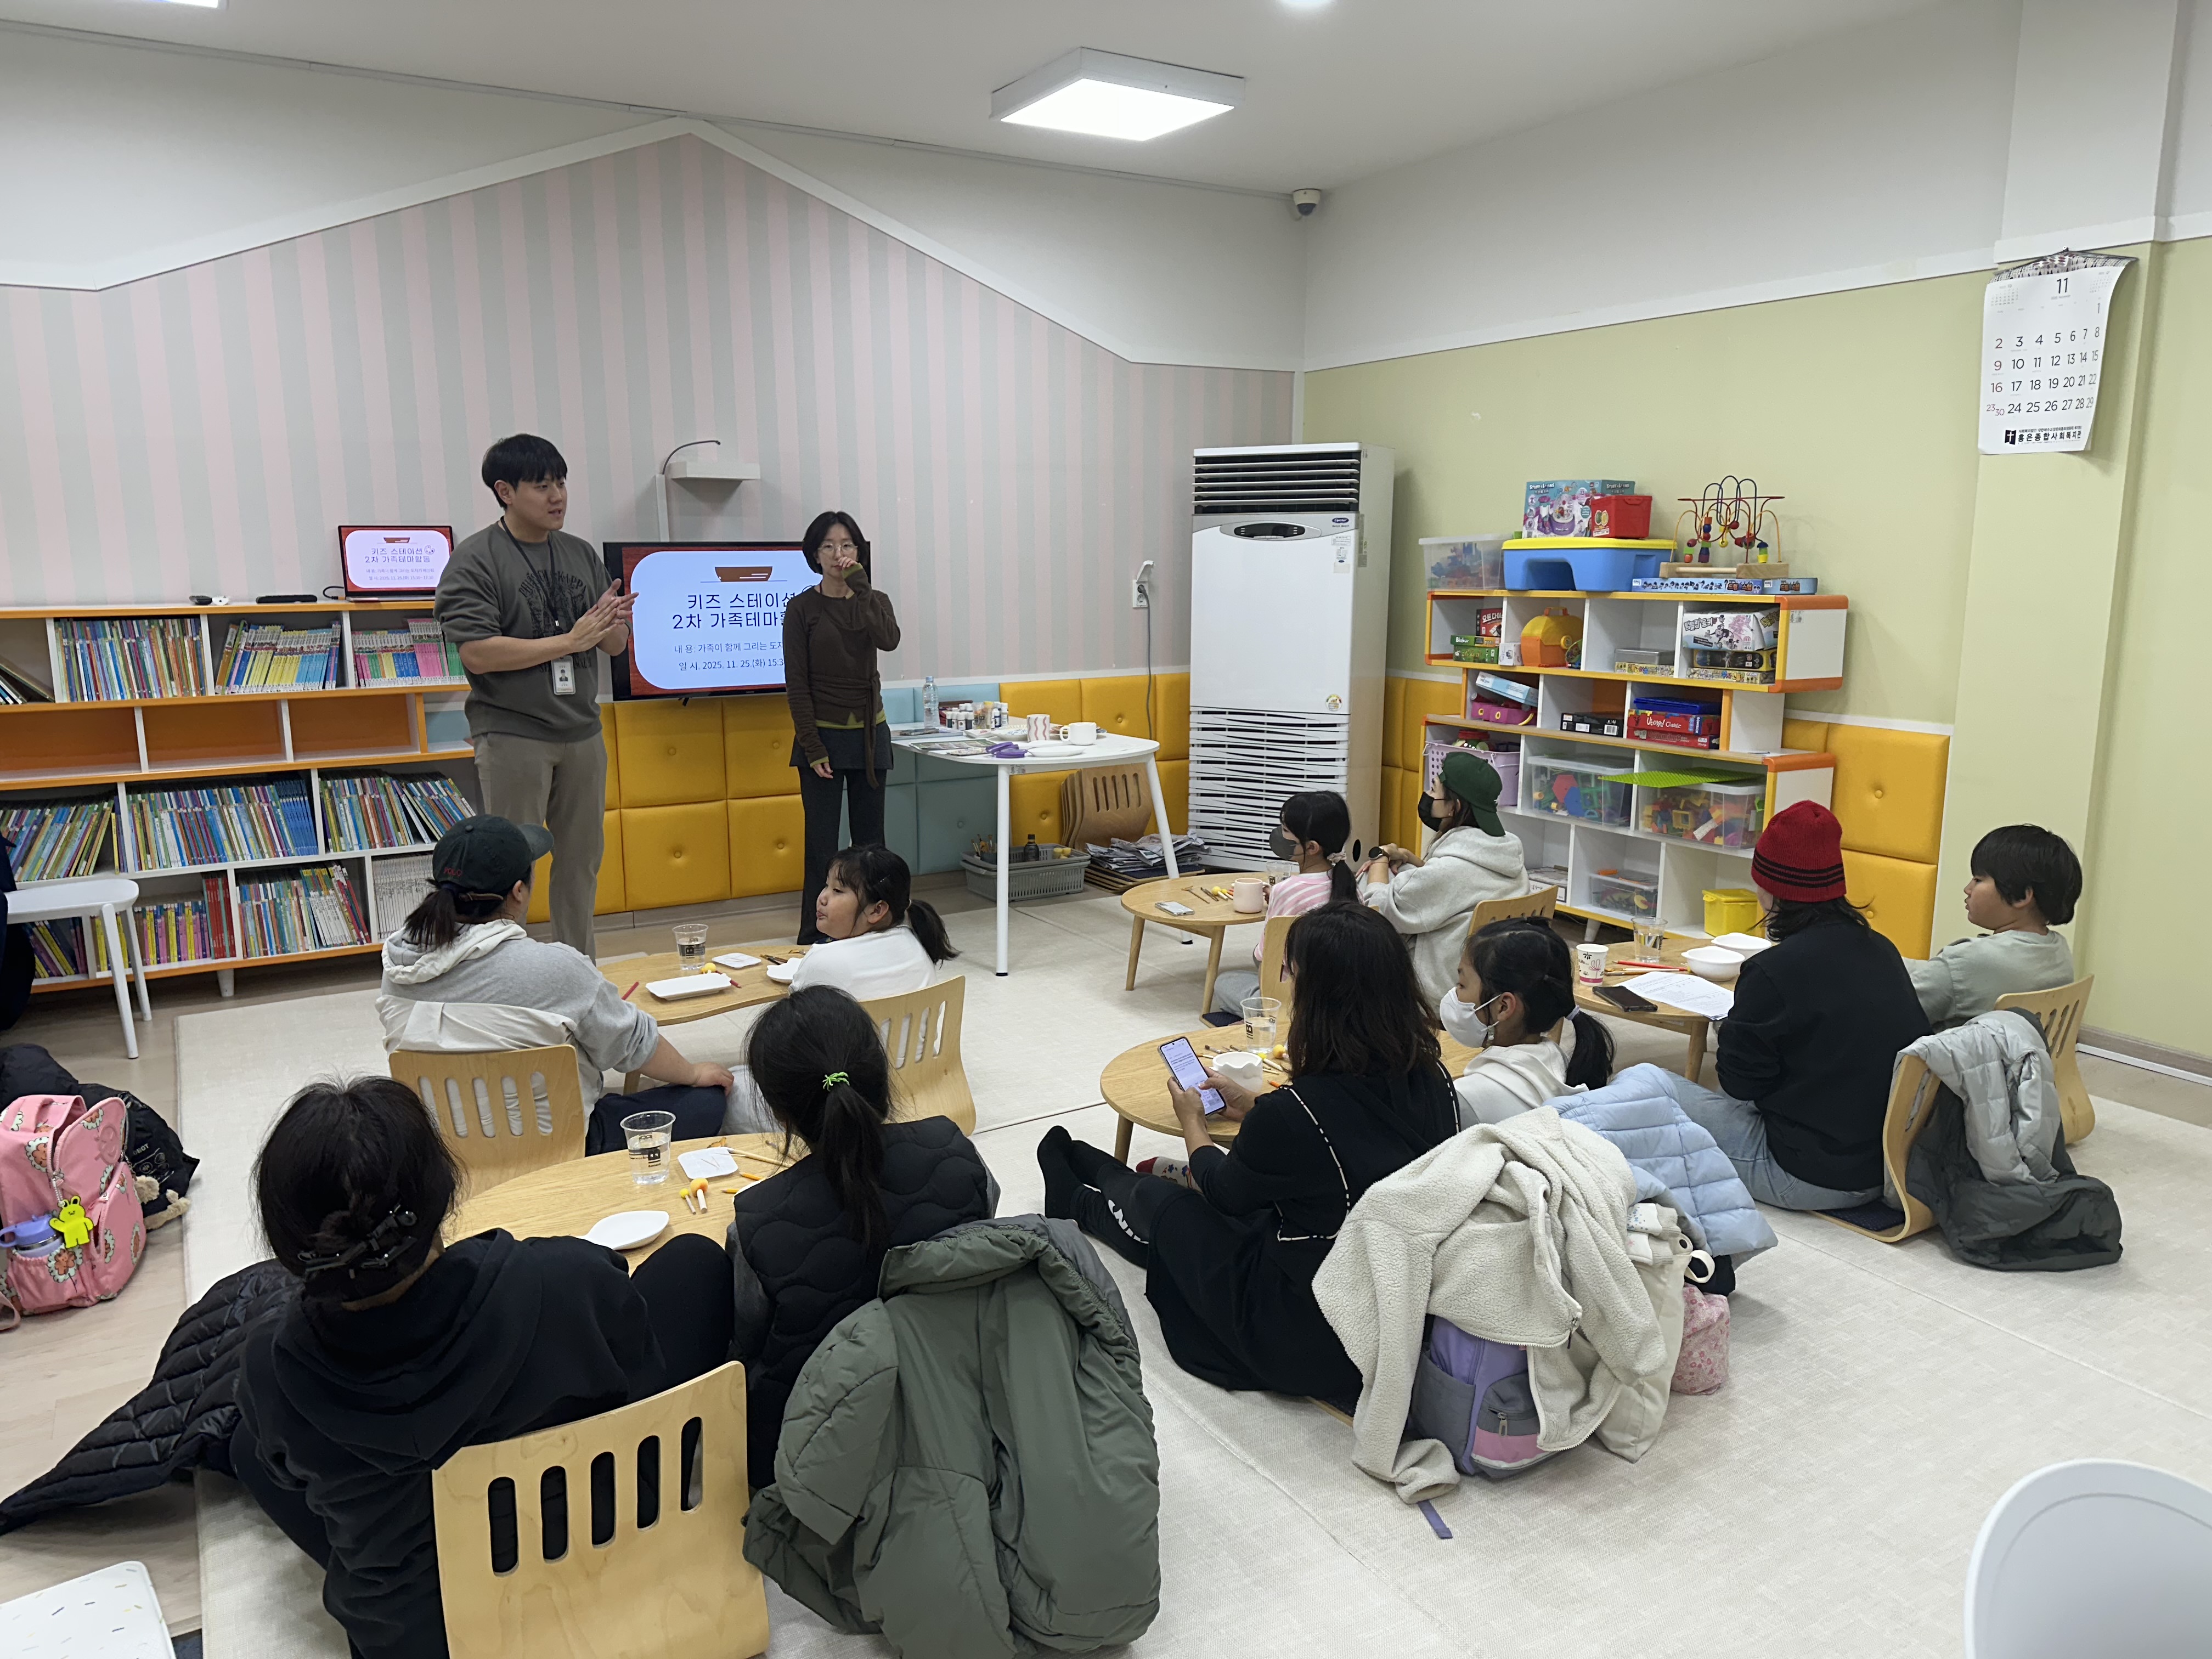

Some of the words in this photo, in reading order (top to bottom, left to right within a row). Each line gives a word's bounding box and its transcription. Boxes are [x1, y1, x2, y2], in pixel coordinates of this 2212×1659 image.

[2057, 278, 2068, 294] 11
[1995, 338, 2003, 348] 2
[2016, 336, 2023, 347] 3
[2035, 335, 2043, 345] 4
[2055, 332, 2061, 343] 5
[2070, 330, 2075, 341] 6
[2084, 329, 2087, 339] 7
[2095, 327, 2100, 337] 8
[1994, 360, 2002, 371] 9
[2012, 359, 2024, 369] 10
[2034, 357, 2041, 368] 11
[2051, 356, 2060, 366] 12
[2067, 353, 2075, 364] 13
[2080, 352, 2087, 363] 14
[2092, 350, 2098, 362] 15
[1991, 382, 2002, 392] 16
[2011, 381, 2022, 391] 17
[2030, 380, 2041, 390] 18
[2049, 378, 2059, 388] 19
[2063, 376, 2075, 387] 20
[2078, 375, 2085, 386] 21
[2089, 374, 2097, 385] 22
[2007, 403, 2021, 414] 24
[2026, 402, 2040, 413] 25
[2045, 400, 2057, 411] 26
[2062, 399, 2073, 410] 27
[2075, 398, 2084, 409] 28
[2086, 397, 2094, 408] 29
[688, 594, 721, 609] 키즈
[673, 613, 702, 629] 2차
[674, 645, 682, 653] 내
[698, 644, 722, 652] 가족이
[725, 642, 741, 652] 함께
[744, 642, 767, 650] 그리는
[679, 662, 686, 670] 일
[443, 866, 463, 877] POLO
